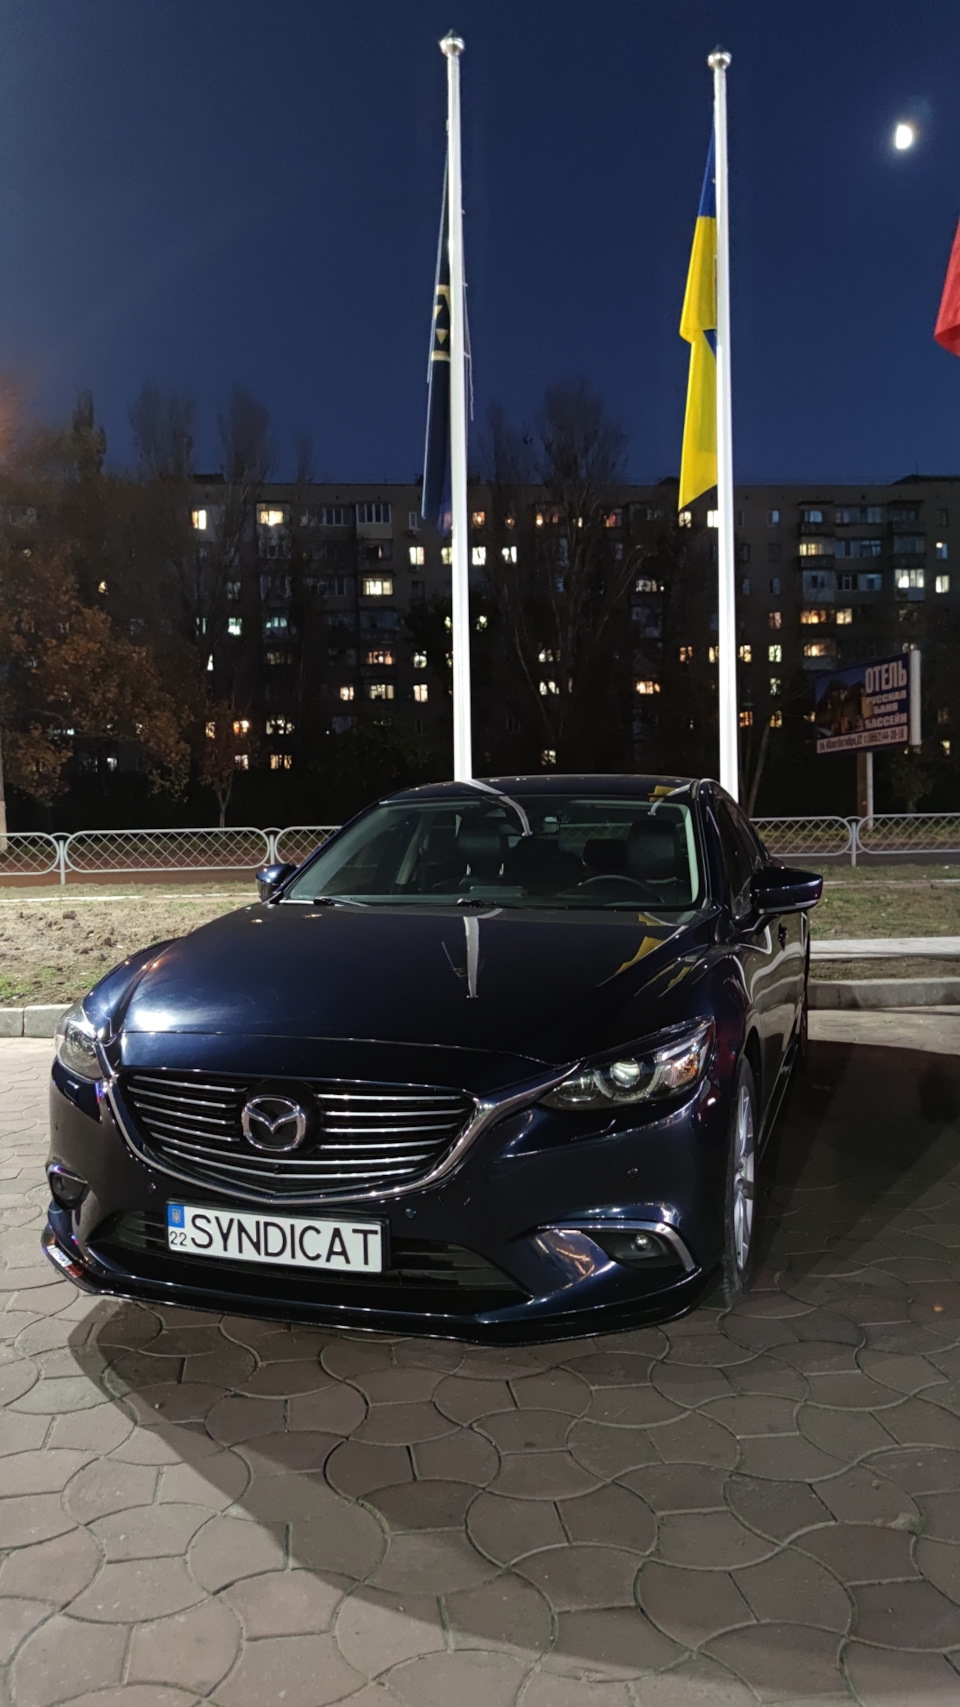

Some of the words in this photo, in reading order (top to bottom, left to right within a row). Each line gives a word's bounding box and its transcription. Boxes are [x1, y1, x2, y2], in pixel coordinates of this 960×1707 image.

[865, 659, 907, 693] ОТЕЛЬ
[865, 712, 907, 729] БАССЕЙН
[169, 1231, 187, 1246] 22
[191, 1213, 379, 1265] SYNDICAT
